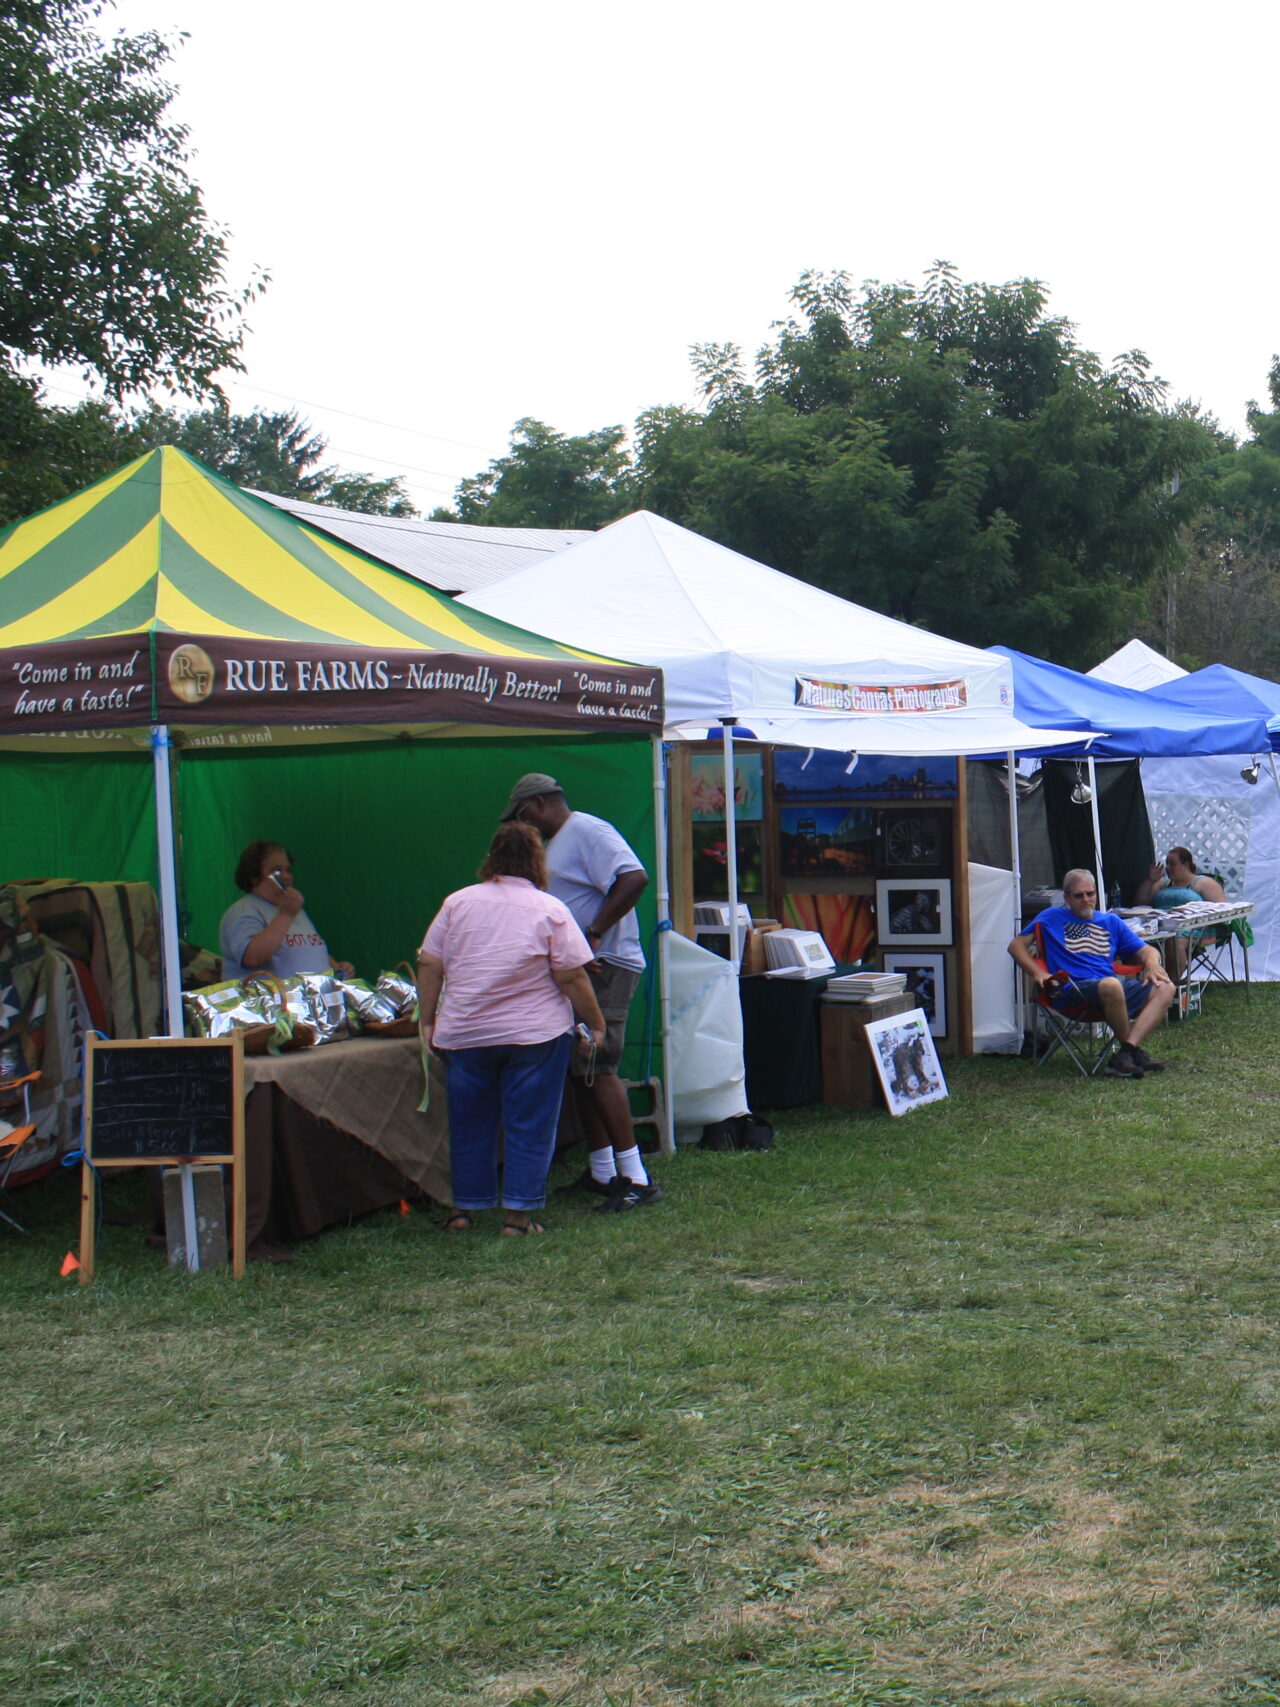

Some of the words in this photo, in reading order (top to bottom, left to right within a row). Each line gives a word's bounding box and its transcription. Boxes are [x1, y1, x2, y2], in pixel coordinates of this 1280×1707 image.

[12, 662, 68, 684] "Come
[74, 662, 91, 681] in
[98, 650, 140, 679] and
[223, 659, 288, 692] RUE
[295, 660, 389, 692] FARMS
[405, 663, 498, 703] Naturally
[501, 671, 562, 702] Better!
[573, 671, 612, 693] "Come
[615, 680, 627, 695] in
[630, 678, 655, 697] and
[851, 687, 893, 711] Canvas
[893, 684, 960, 710] Photography
[14, 689, 56, 715] have
[62, 698, 73, 712] a
[81, 684, 144, 712] taste!"
[576, 695, 605, 715] have
[608, 706, 617, 717] a
